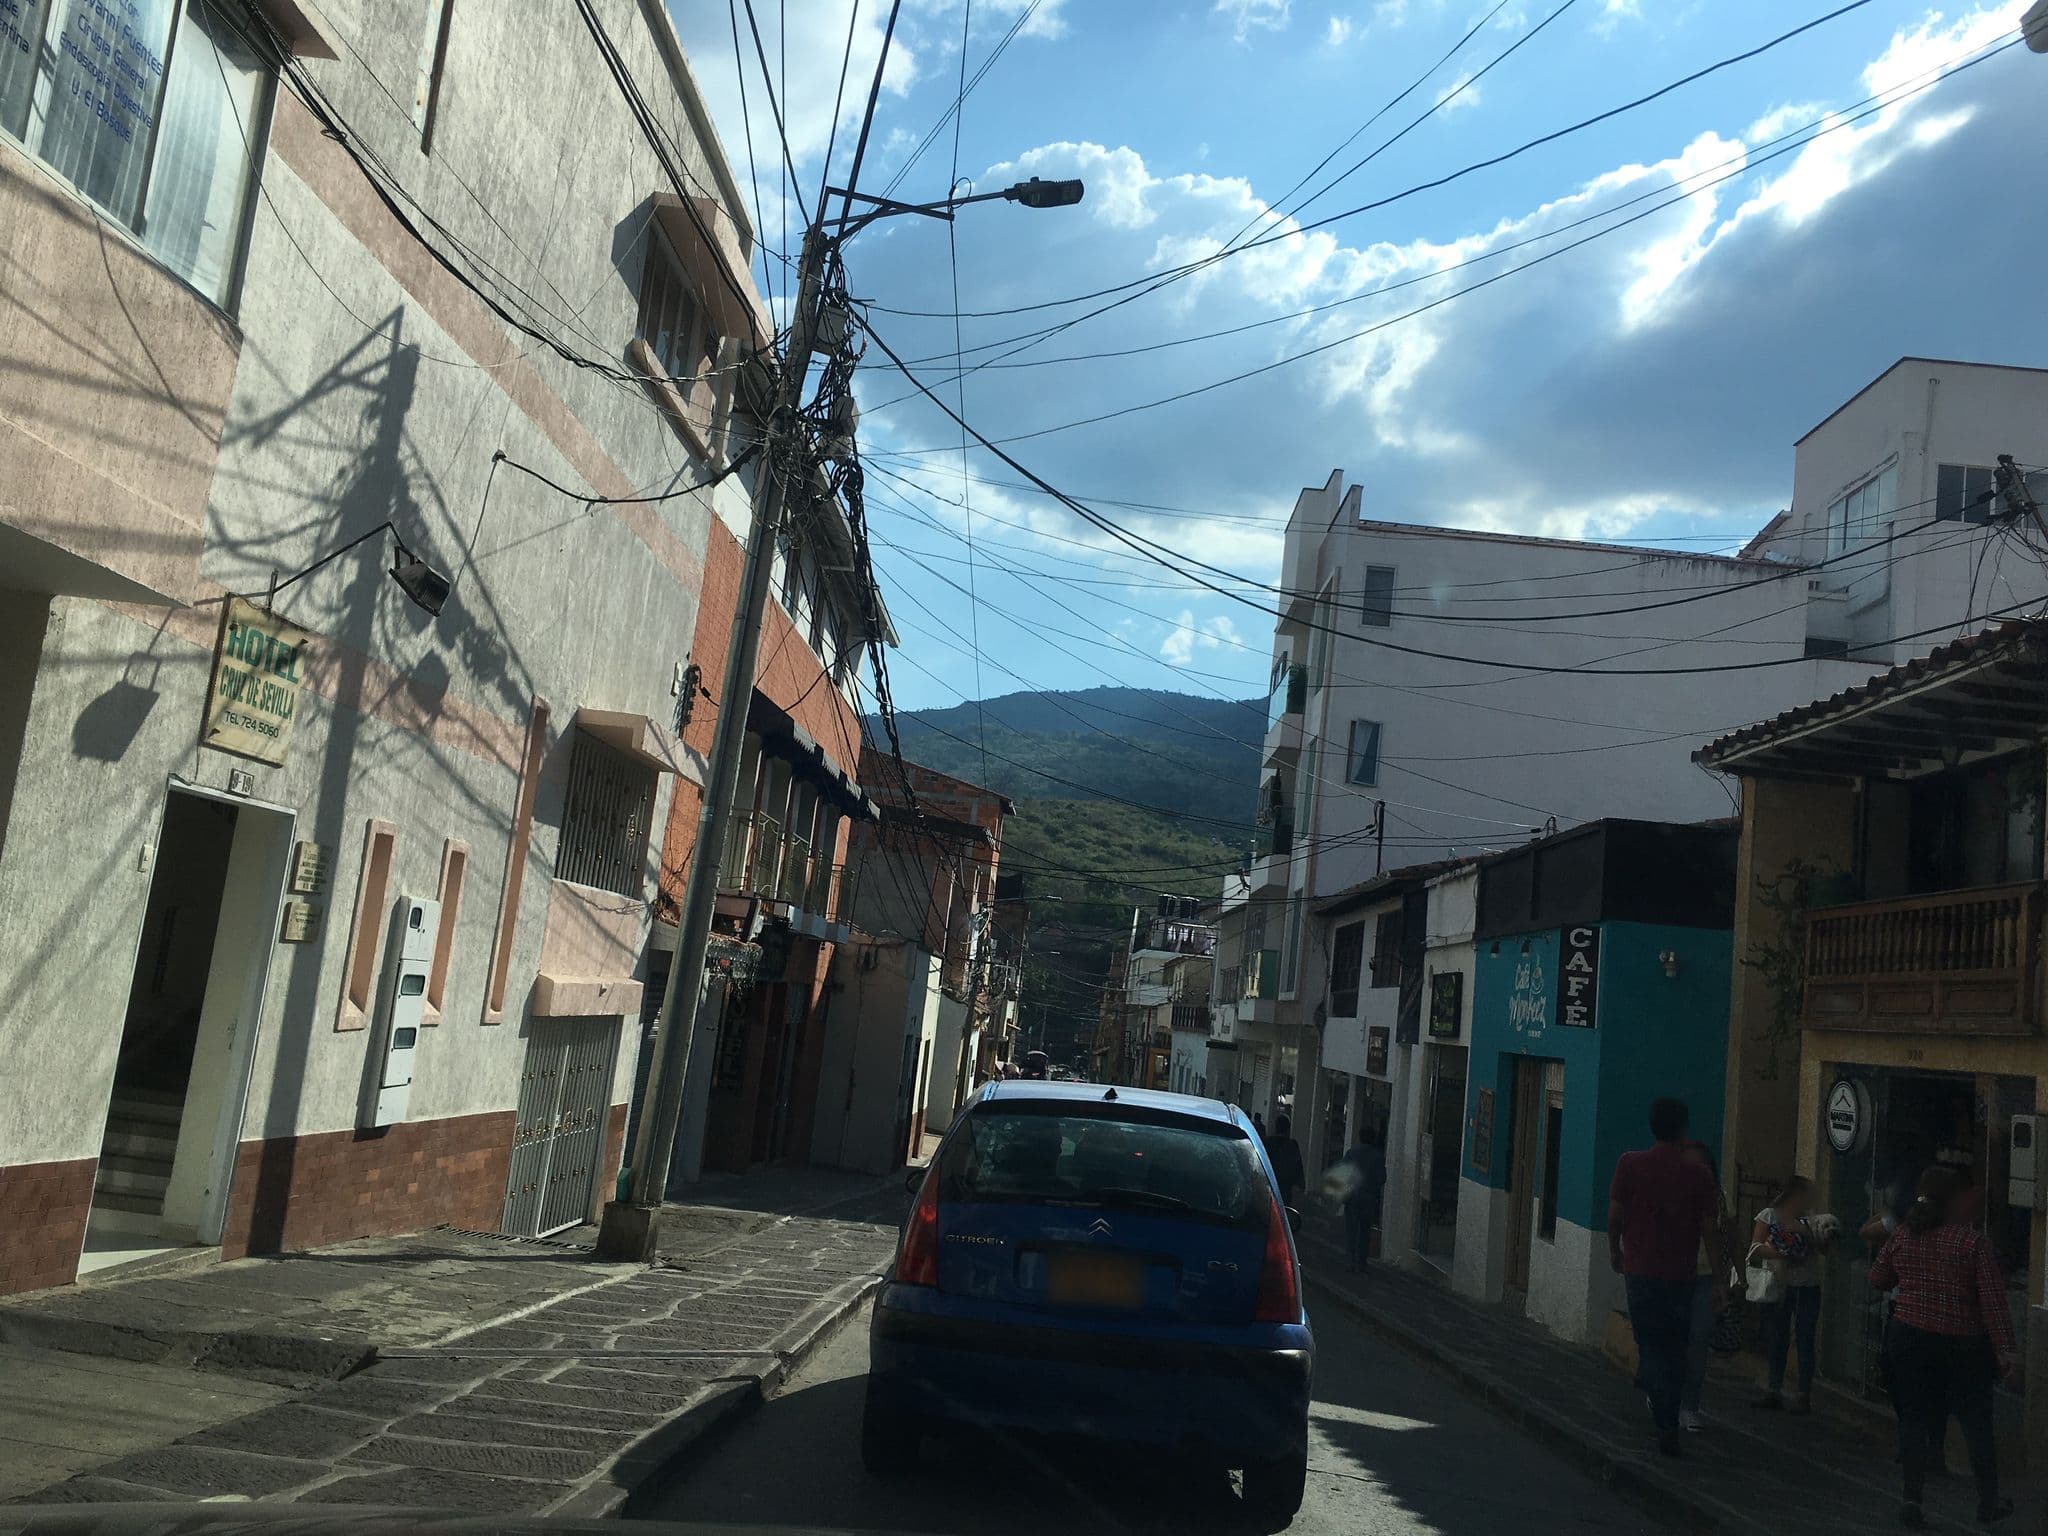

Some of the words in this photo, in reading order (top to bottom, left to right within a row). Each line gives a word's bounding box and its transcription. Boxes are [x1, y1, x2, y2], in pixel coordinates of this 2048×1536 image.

[114, 48, 147, 91] General
[121, 24, 163, 77] Fuentes
[97, 101, 130, 142] Bosque
[227, 623, 299, 685] HOTEL
[219, 664, 248, 703] CRUZ
[246, 676, 261, 708] DE
[260, 680, 294, 721] SEVILLA
[241, 715, 257, 731] 724
[258, 722, 279, 738] 5060
[1566, 928, 1593, 1026] CAFÉ
